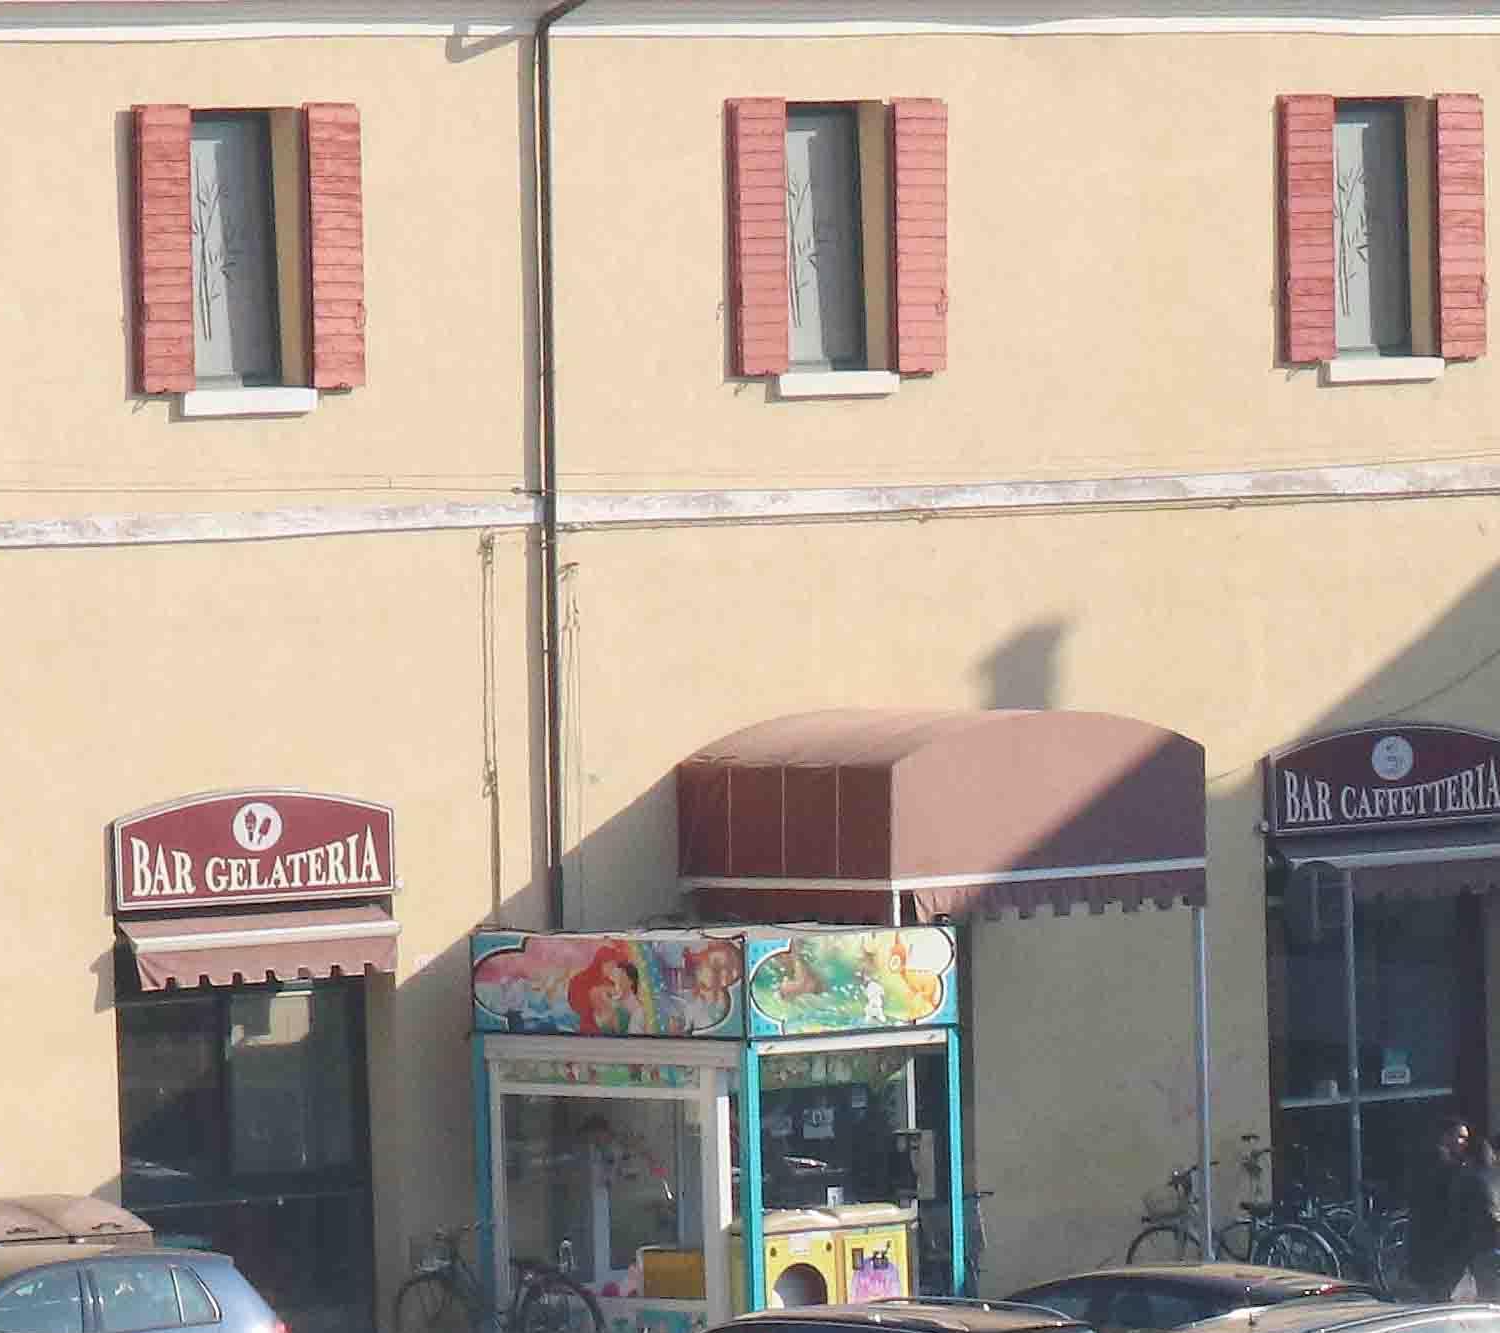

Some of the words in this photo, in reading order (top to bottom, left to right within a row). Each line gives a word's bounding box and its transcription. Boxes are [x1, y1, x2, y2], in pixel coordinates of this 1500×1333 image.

[1284, 768, 1333, 823] BAR
[130, 836, 196, 897] BAR
[204, 824, 382, 893] GELATERIA
